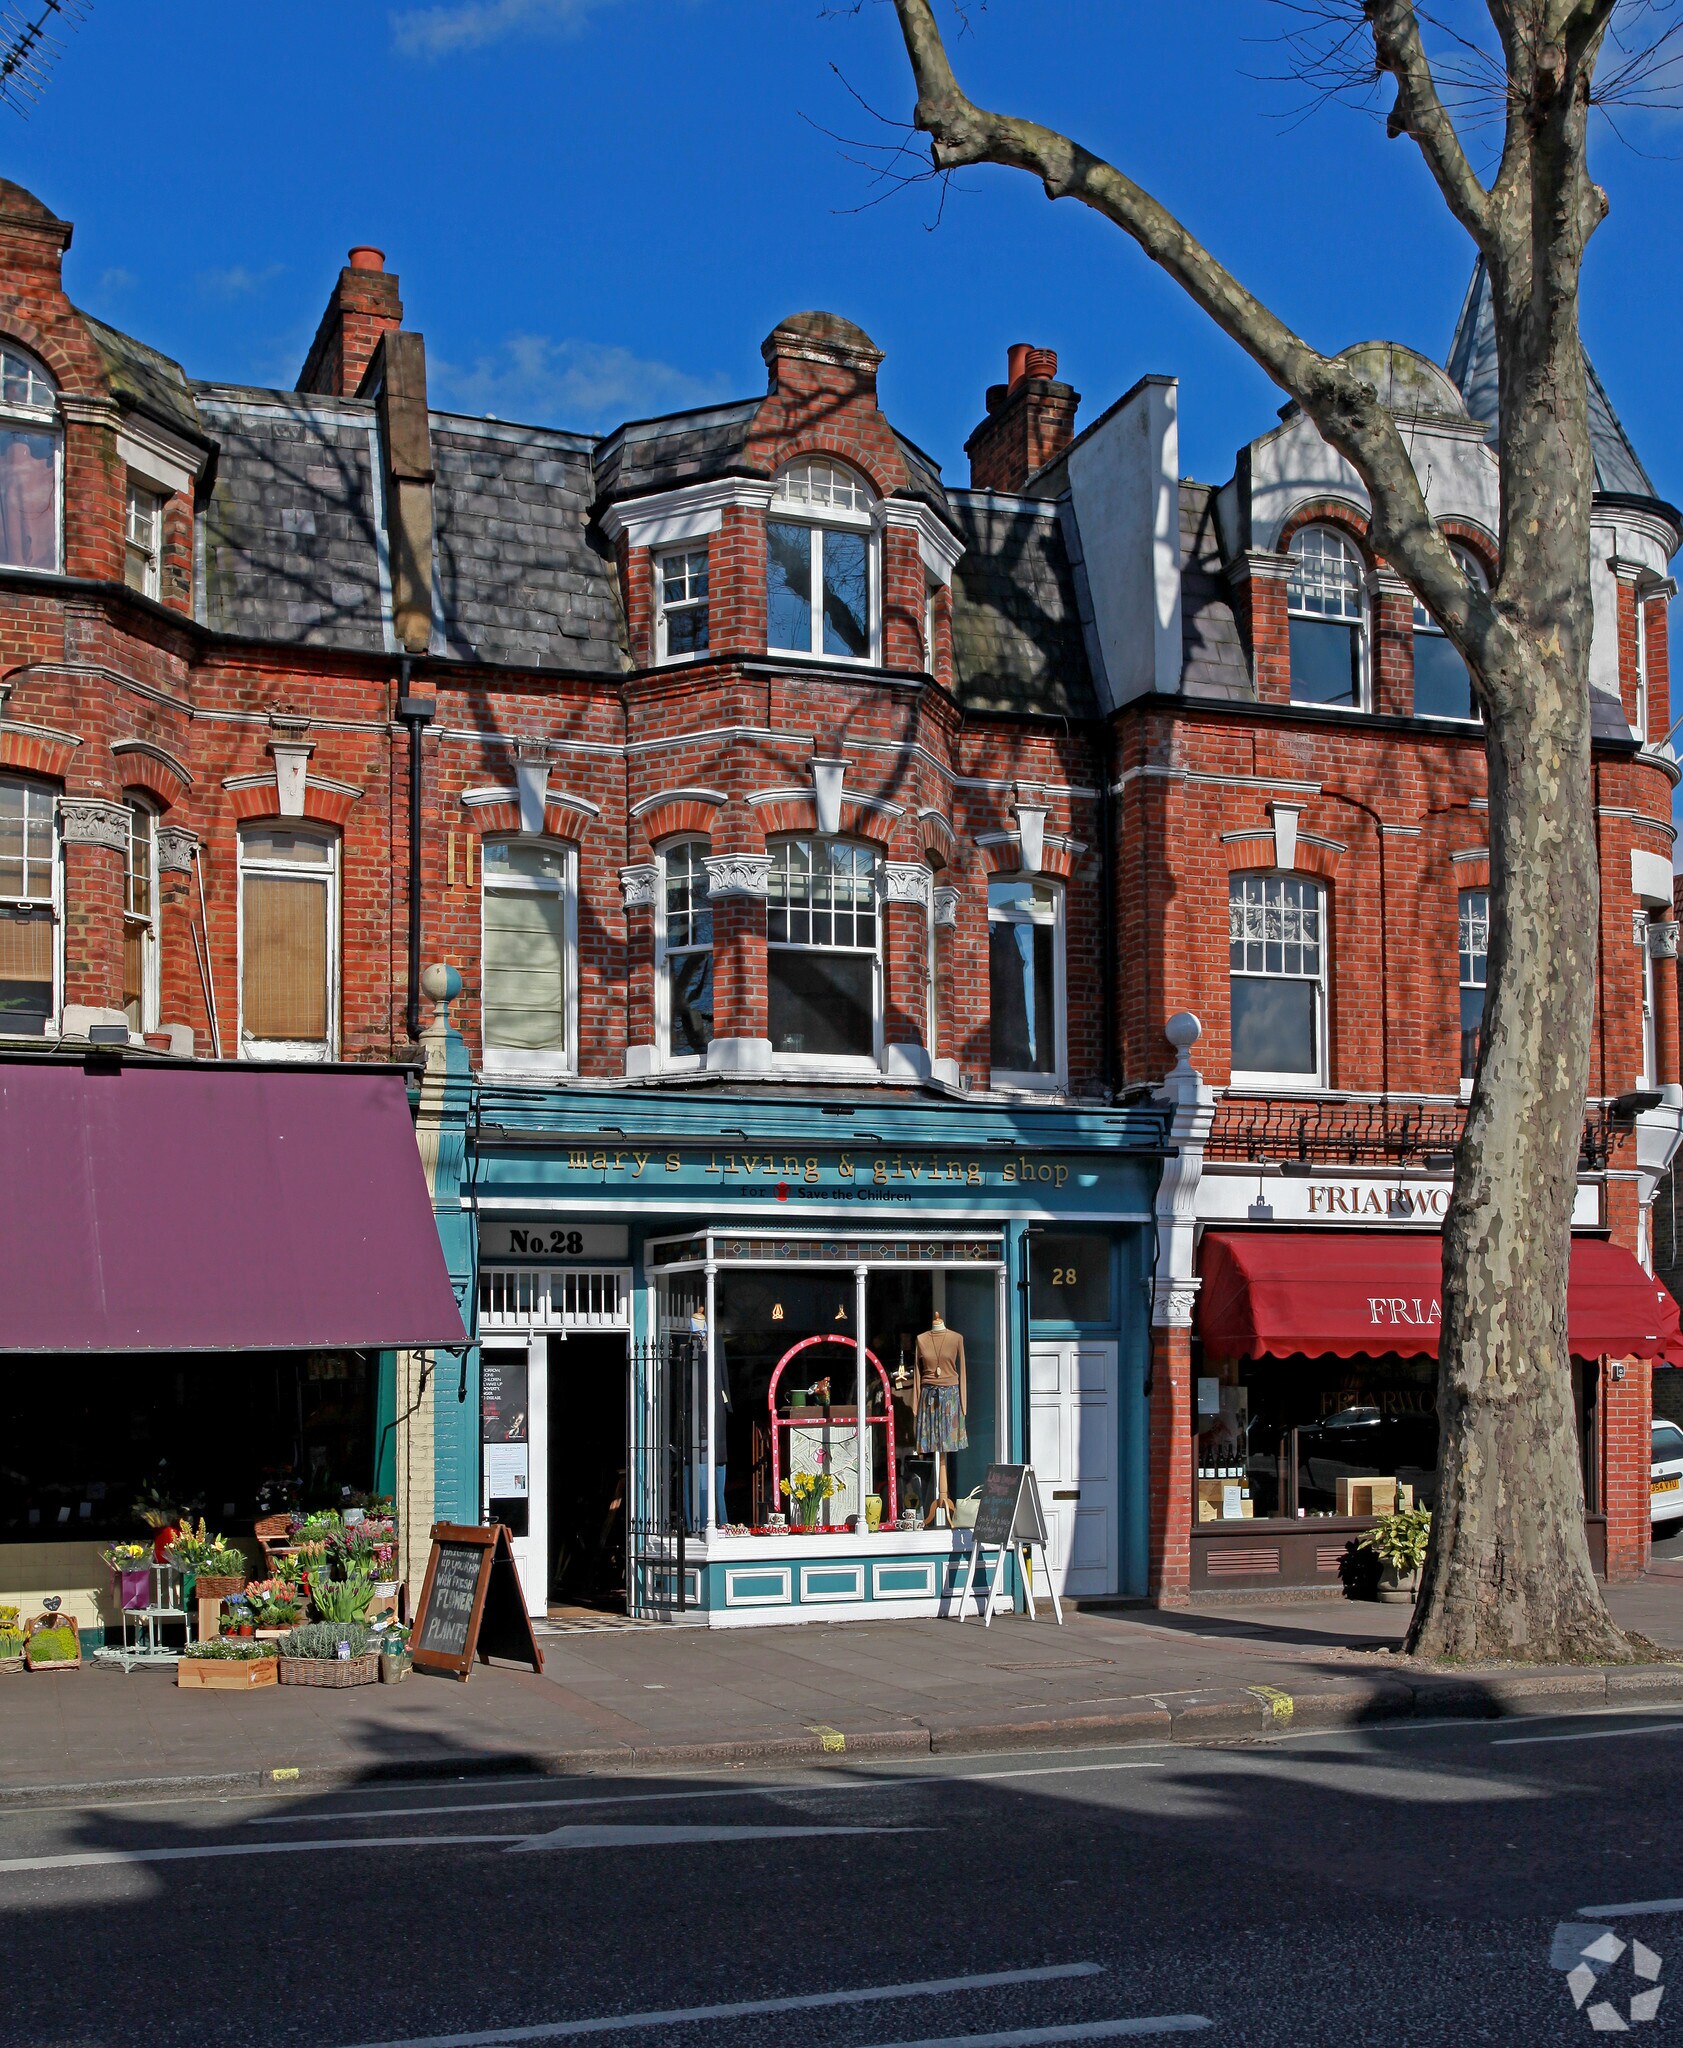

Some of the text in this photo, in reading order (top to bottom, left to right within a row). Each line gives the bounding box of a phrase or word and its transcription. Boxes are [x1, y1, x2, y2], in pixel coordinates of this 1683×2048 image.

[567, 1150, 1069, 1188] marys living & giving shop
[740, 1186, 912, 1202] for Save the Children
[509, 1230, 583, 1254] No.28
[1052, 1268, 1077, 1285] 28
